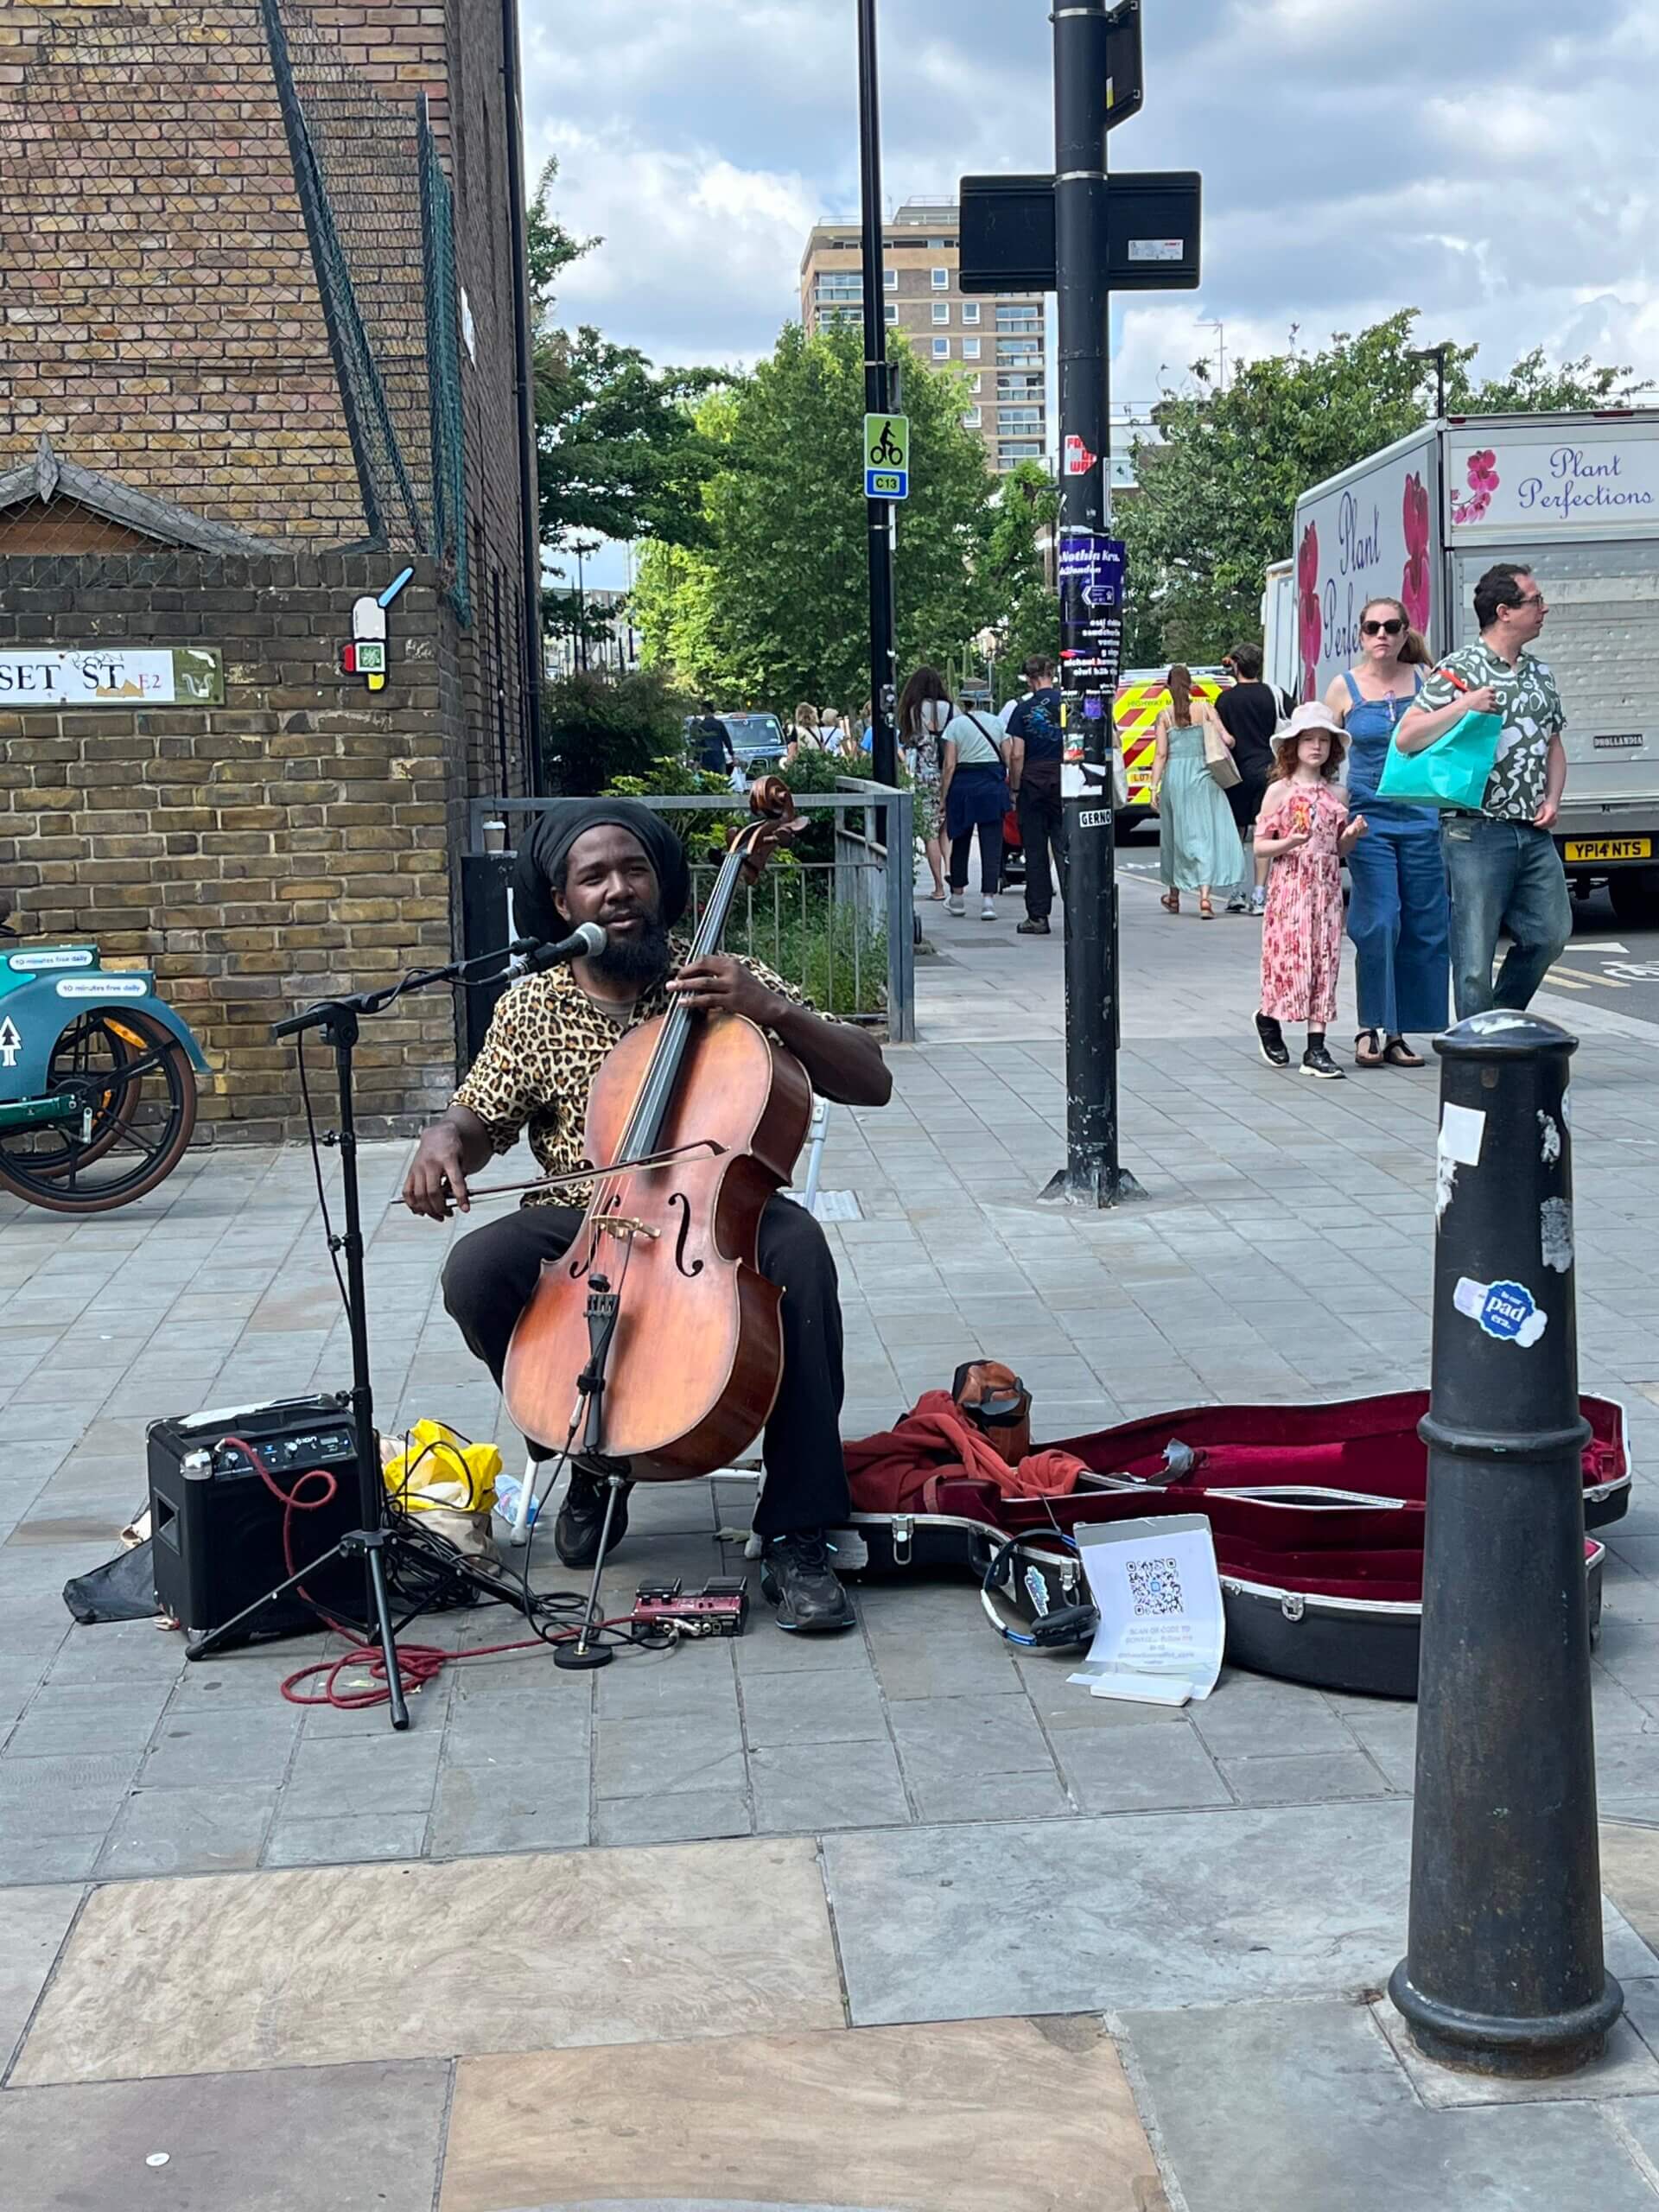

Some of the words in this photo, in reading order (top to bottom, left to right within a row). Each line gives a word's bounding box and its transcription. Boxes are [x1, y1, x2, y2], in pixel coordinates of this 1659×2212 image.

[1550, 448, 1623, 479] Plant
[1517, 477, 1655, 519] Perfections
[1338, 491, 1382, 575] Plant
[83, 664, 124, 690] ST
[138, 674, 162, 689] E2
[1574, 842, 1609, 858] YP14
[1612, 842, 1642, 855] NTS
[1486, 1297, 1527, 1322] pad
